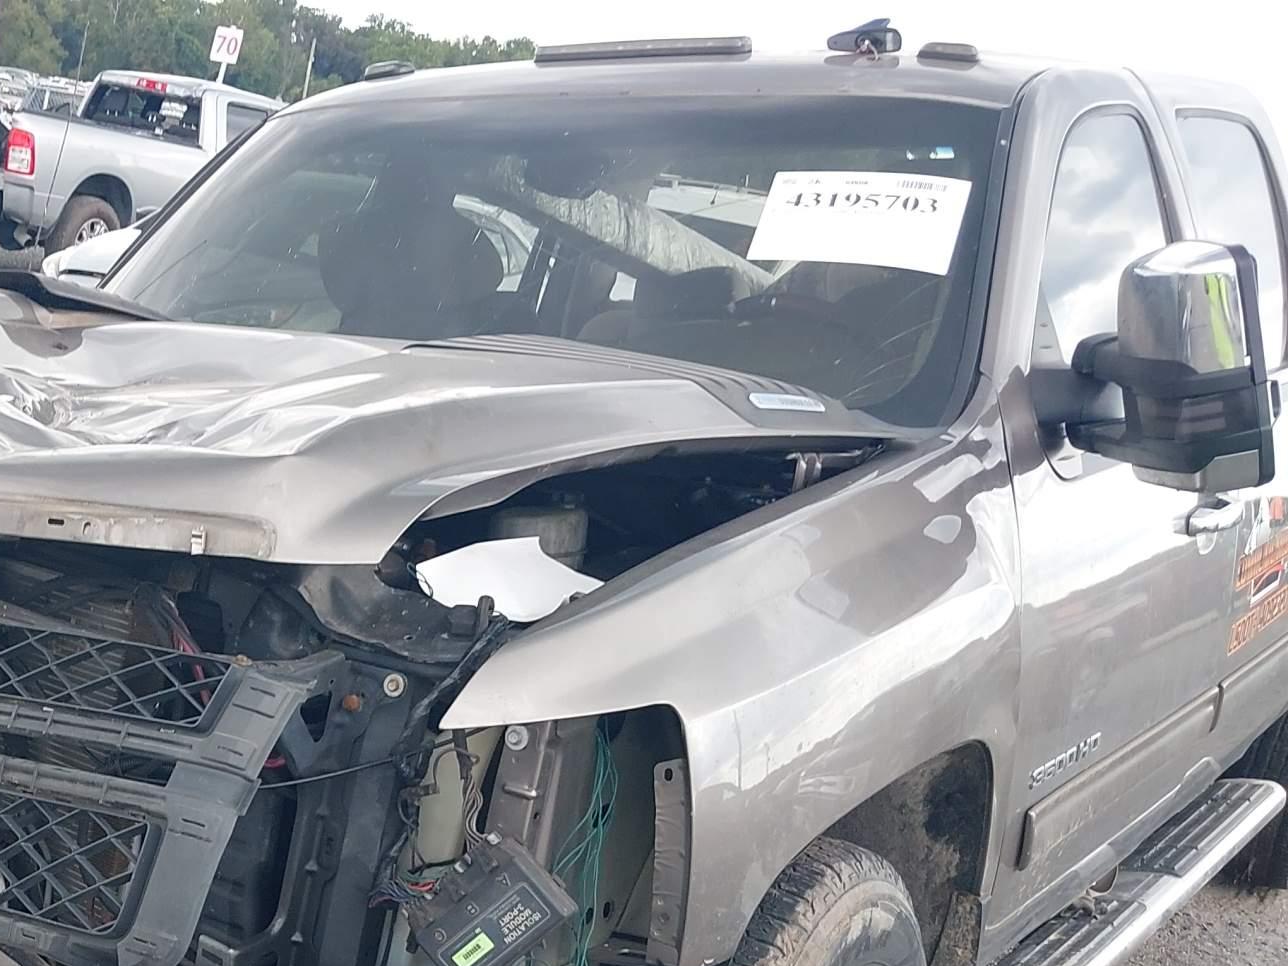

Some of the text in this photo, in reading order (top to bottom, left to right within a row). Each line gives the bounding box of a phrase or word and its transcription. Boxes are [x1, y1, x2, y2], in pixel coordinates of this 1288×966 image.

[216, 35, 238, 56] 70
[785, 192, 938, 213] 43195703
[495, 872, 511, 887] A
[498, 902, 525, 926] 3-PORT
[501, 908, 532, 935] MODULE
[504, 911, 542, 945] ISOLATION
